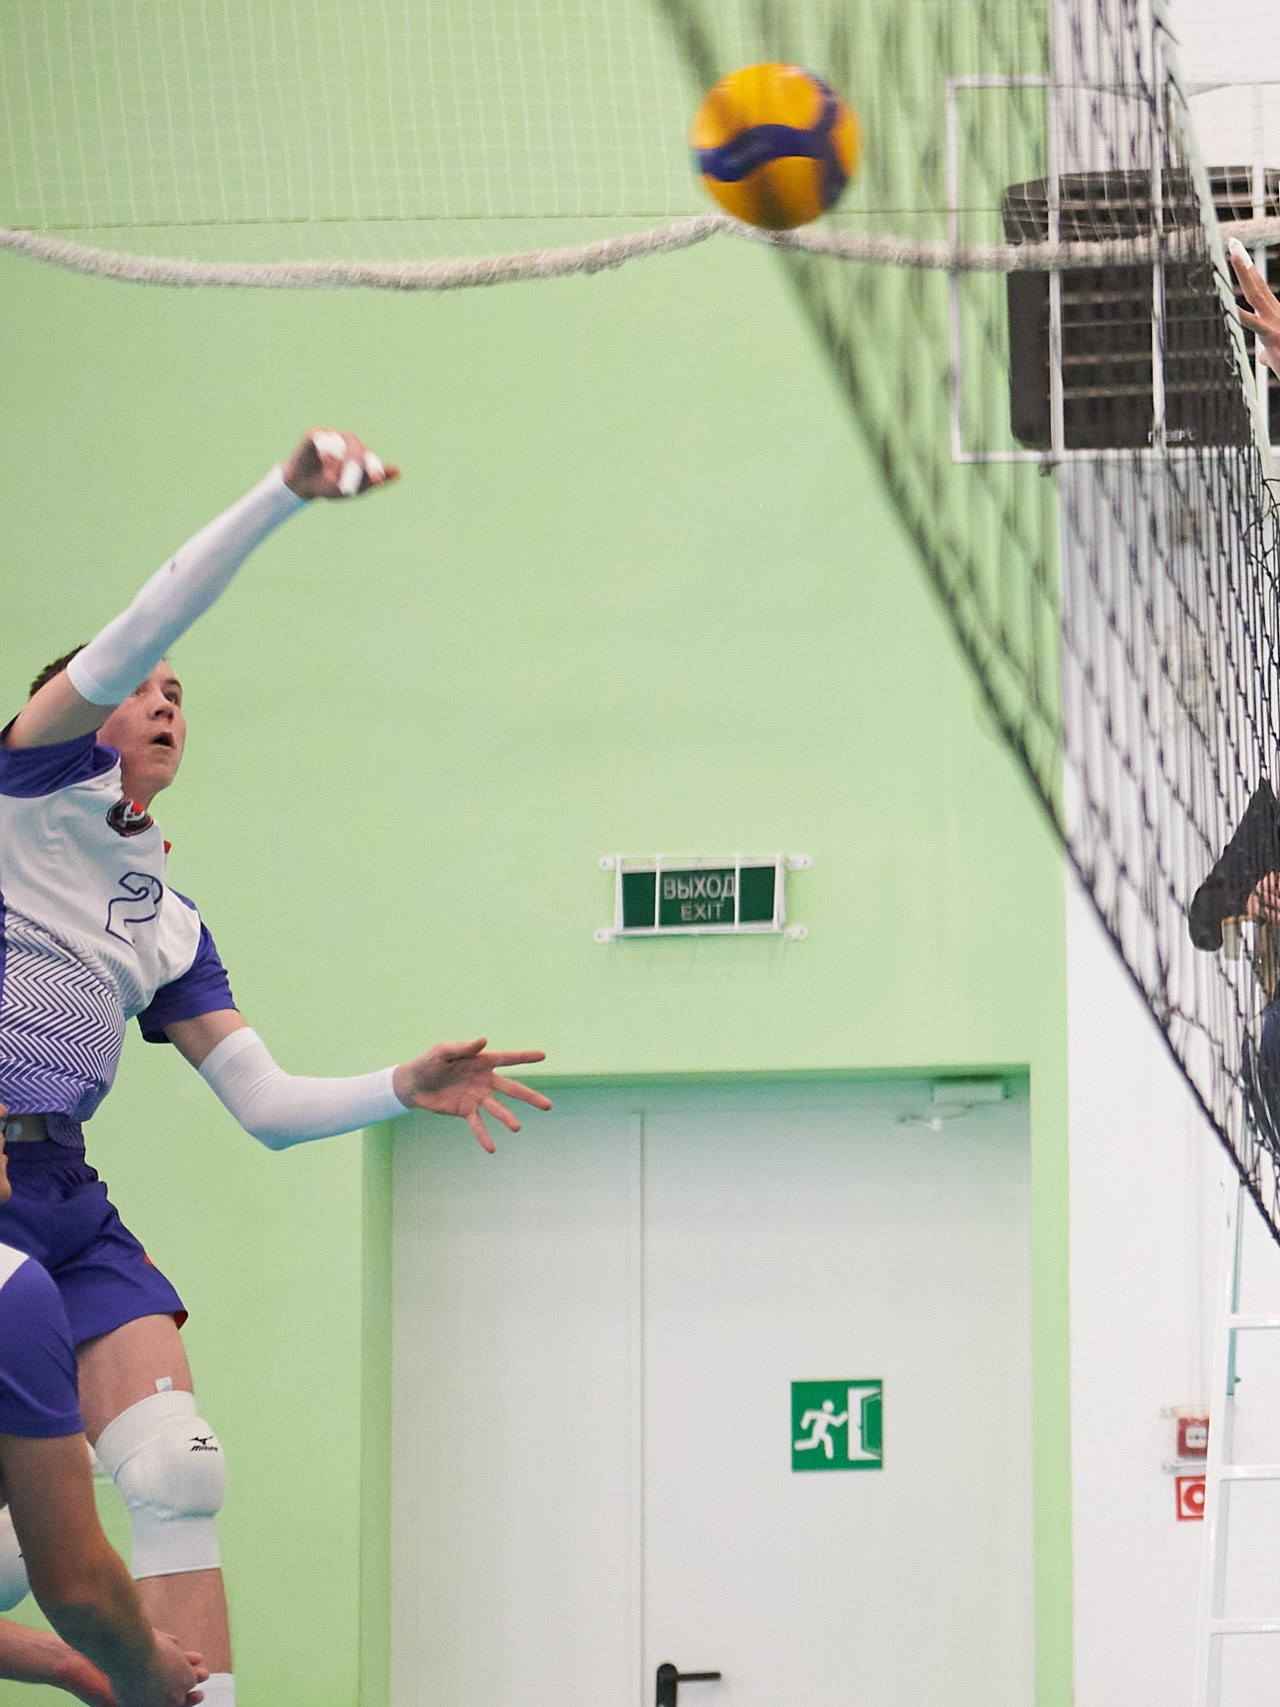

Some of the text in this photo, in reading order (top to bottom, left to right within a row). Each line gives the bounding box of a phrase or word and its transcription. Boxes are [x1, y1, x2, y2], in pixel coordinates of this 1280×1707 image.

[663, 875, 735, 901] ВЫХОД
[105, 871, 163, 947] 2
[681, 903, 724, 921] EXIT
